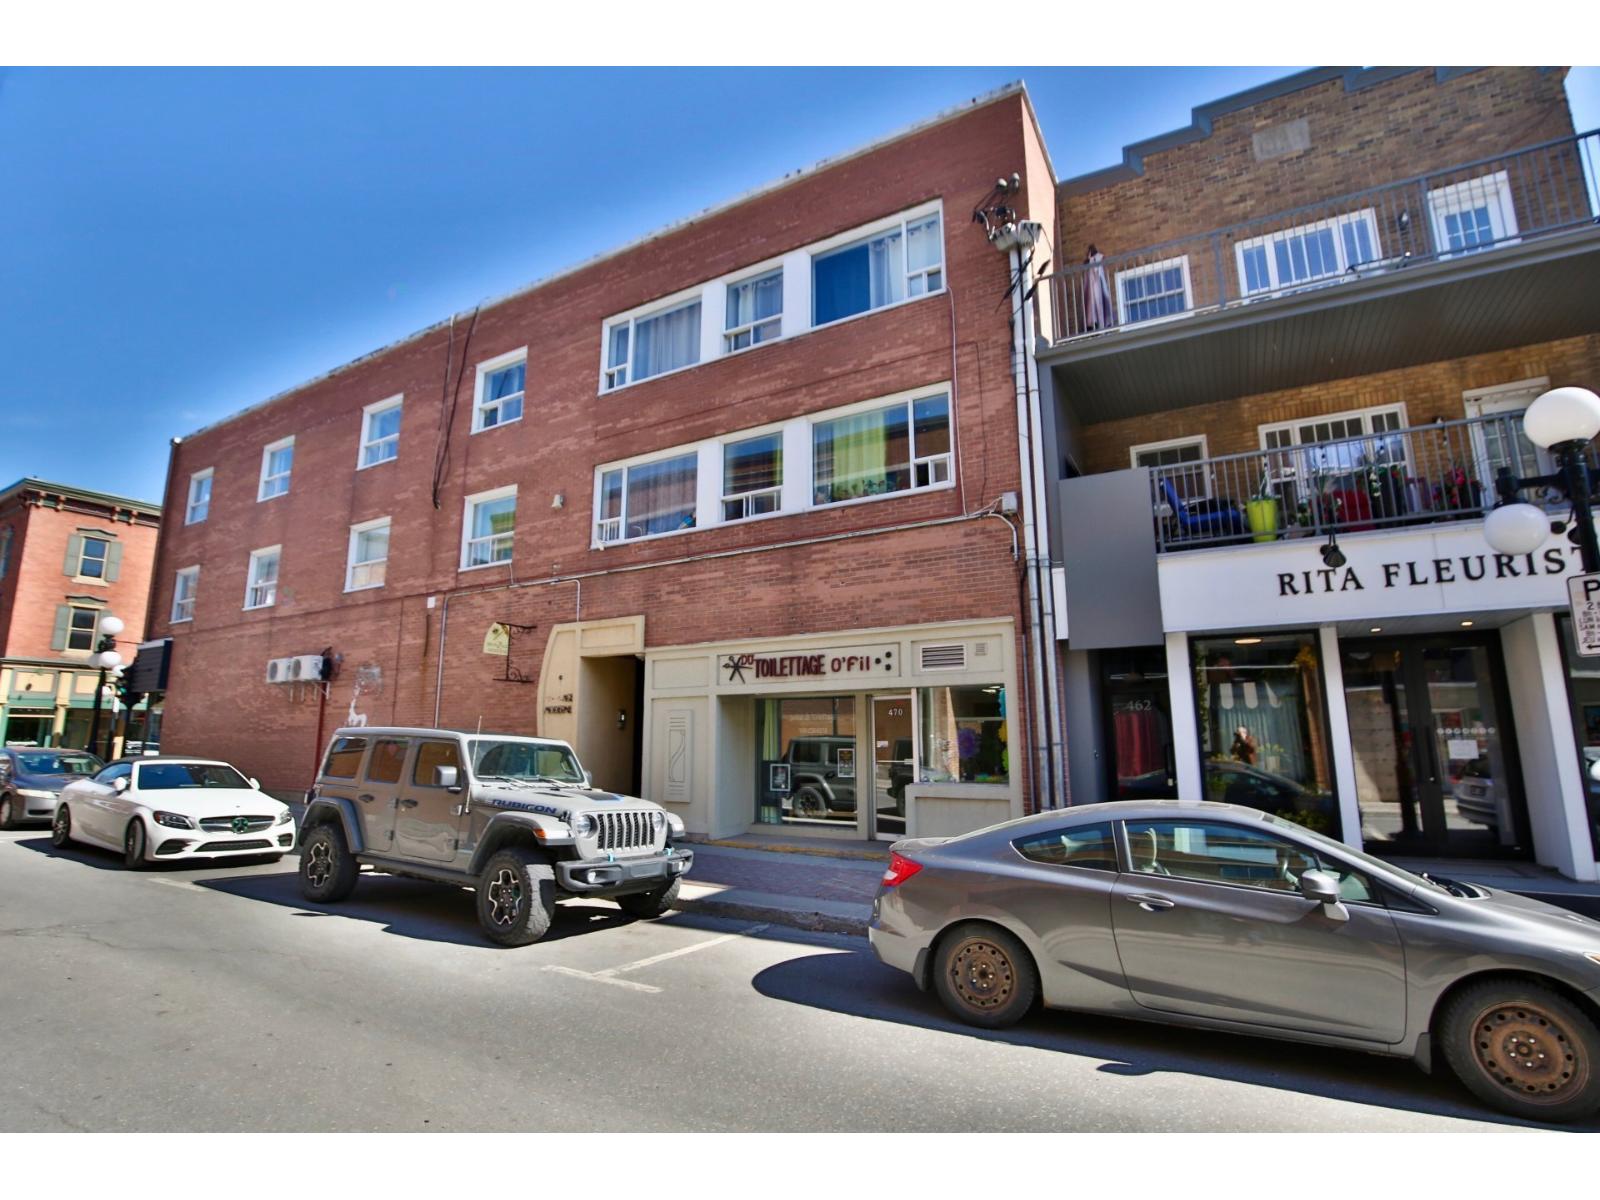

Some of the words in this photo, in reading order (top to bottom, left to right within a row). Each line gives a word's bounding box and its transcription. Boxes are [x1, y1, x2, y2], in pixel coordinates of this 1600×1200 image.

[1277, 566, 1365, 596] RITA
[755, 654, 826, 678] TOILETTAGE
[888, 708, 903, 717] 470
[1127, 699, 1152, 711] 462
[492, 799, 557, 814] RUBICON
